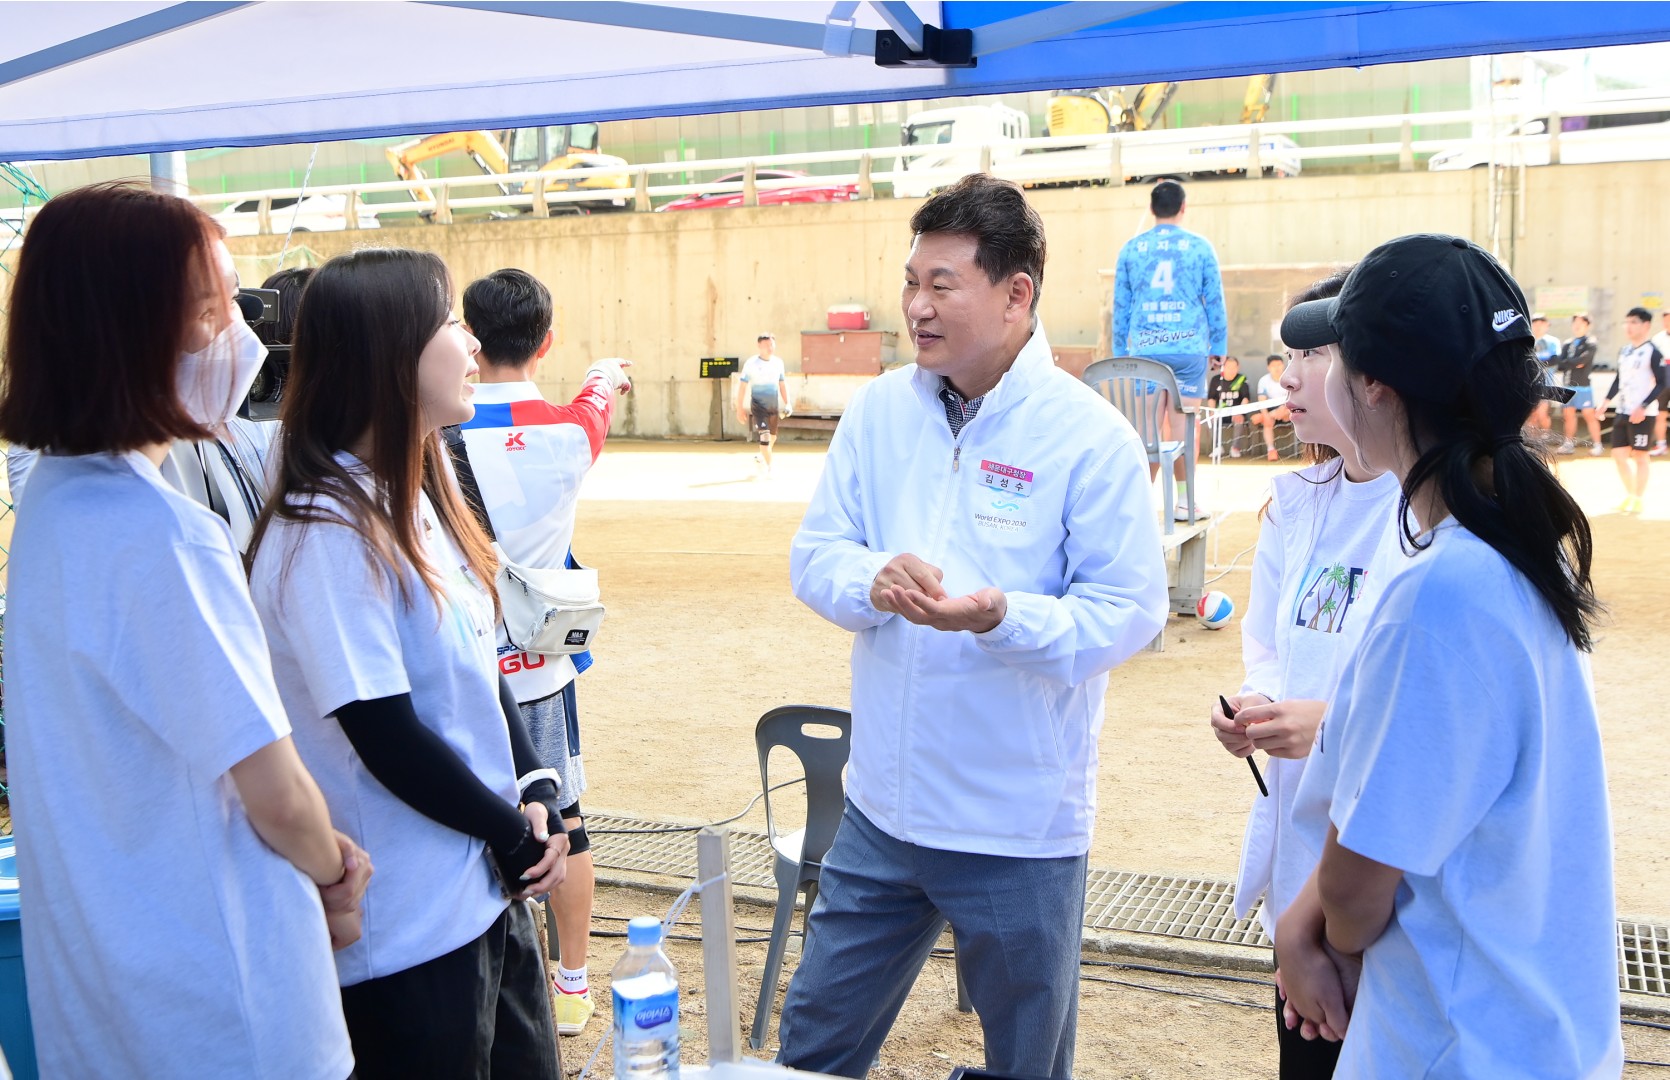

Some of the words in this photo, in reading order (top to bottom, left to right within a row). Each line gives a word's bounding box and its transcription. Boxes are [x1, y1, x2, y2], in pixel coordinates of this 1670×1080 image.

[1150, 260, 1174, 295] 4
[1494, 309, 1514, 323] NIKE
[985, 473, 993, 484] 김
[1000, 478, 1008, 488] 성
[1015, 482, 1024, 491] 수
[974, 513, 993, 521] World
[993, 516, 1011, 525] EXPO
[1011, 519, 1027, 527] 2030
